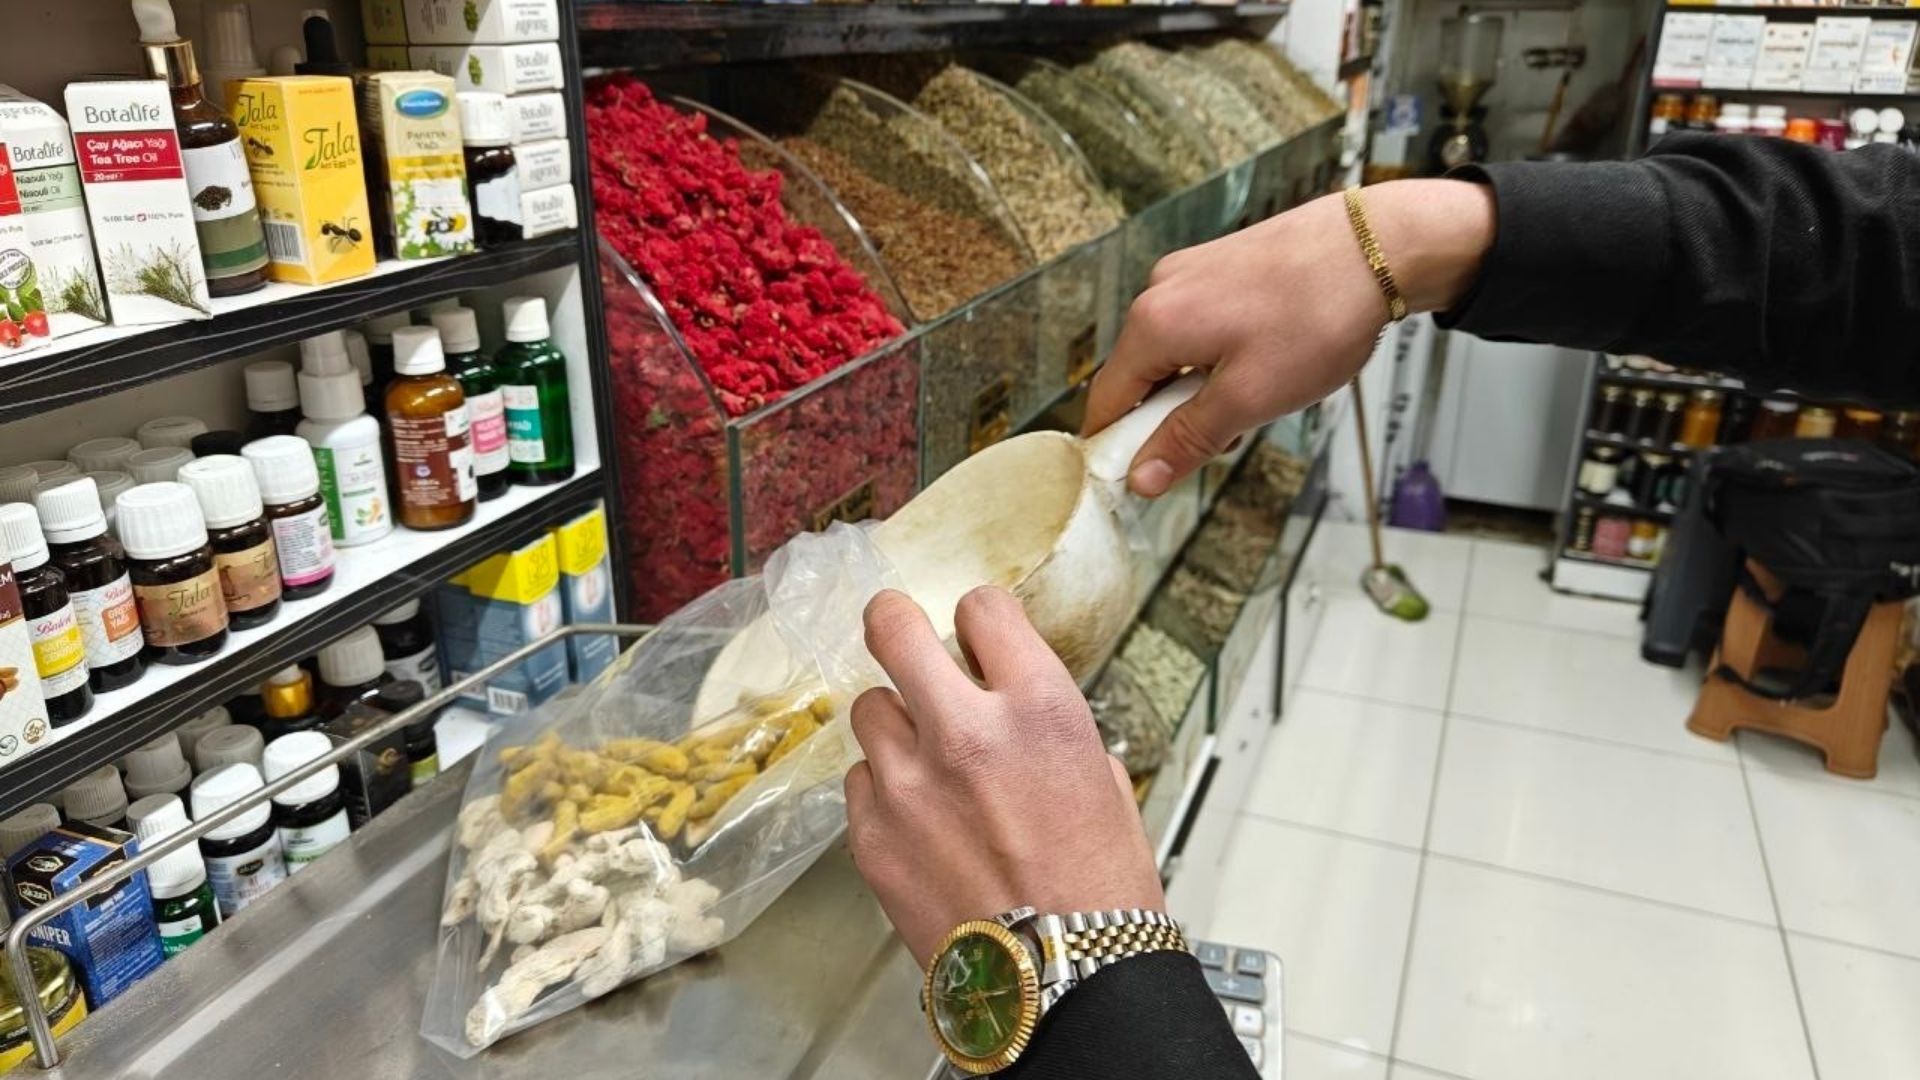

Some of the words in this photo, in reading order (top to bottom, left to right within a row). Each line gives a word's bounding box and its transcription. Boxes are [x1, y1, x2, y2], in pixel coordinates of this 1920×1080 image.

[84, 102, 161, 124] Botalife
[238, 91, 277, 127] Tala
[12, 141, 64, 162] Botalife
[86, 139, 109, 152] Çay
[111, 138, 144, 152] Ağacı
[145, 137, 168, 149] Yağı
[303, 121, 356, 169] Tala
[90, 154, 113, 165] Tea
[114, 153, 141, 164] Tree
[142, 152, 159, 162] Oil
[166, 583, 212, 616] Tala
[31, 924, 73, 947] UNIPER
